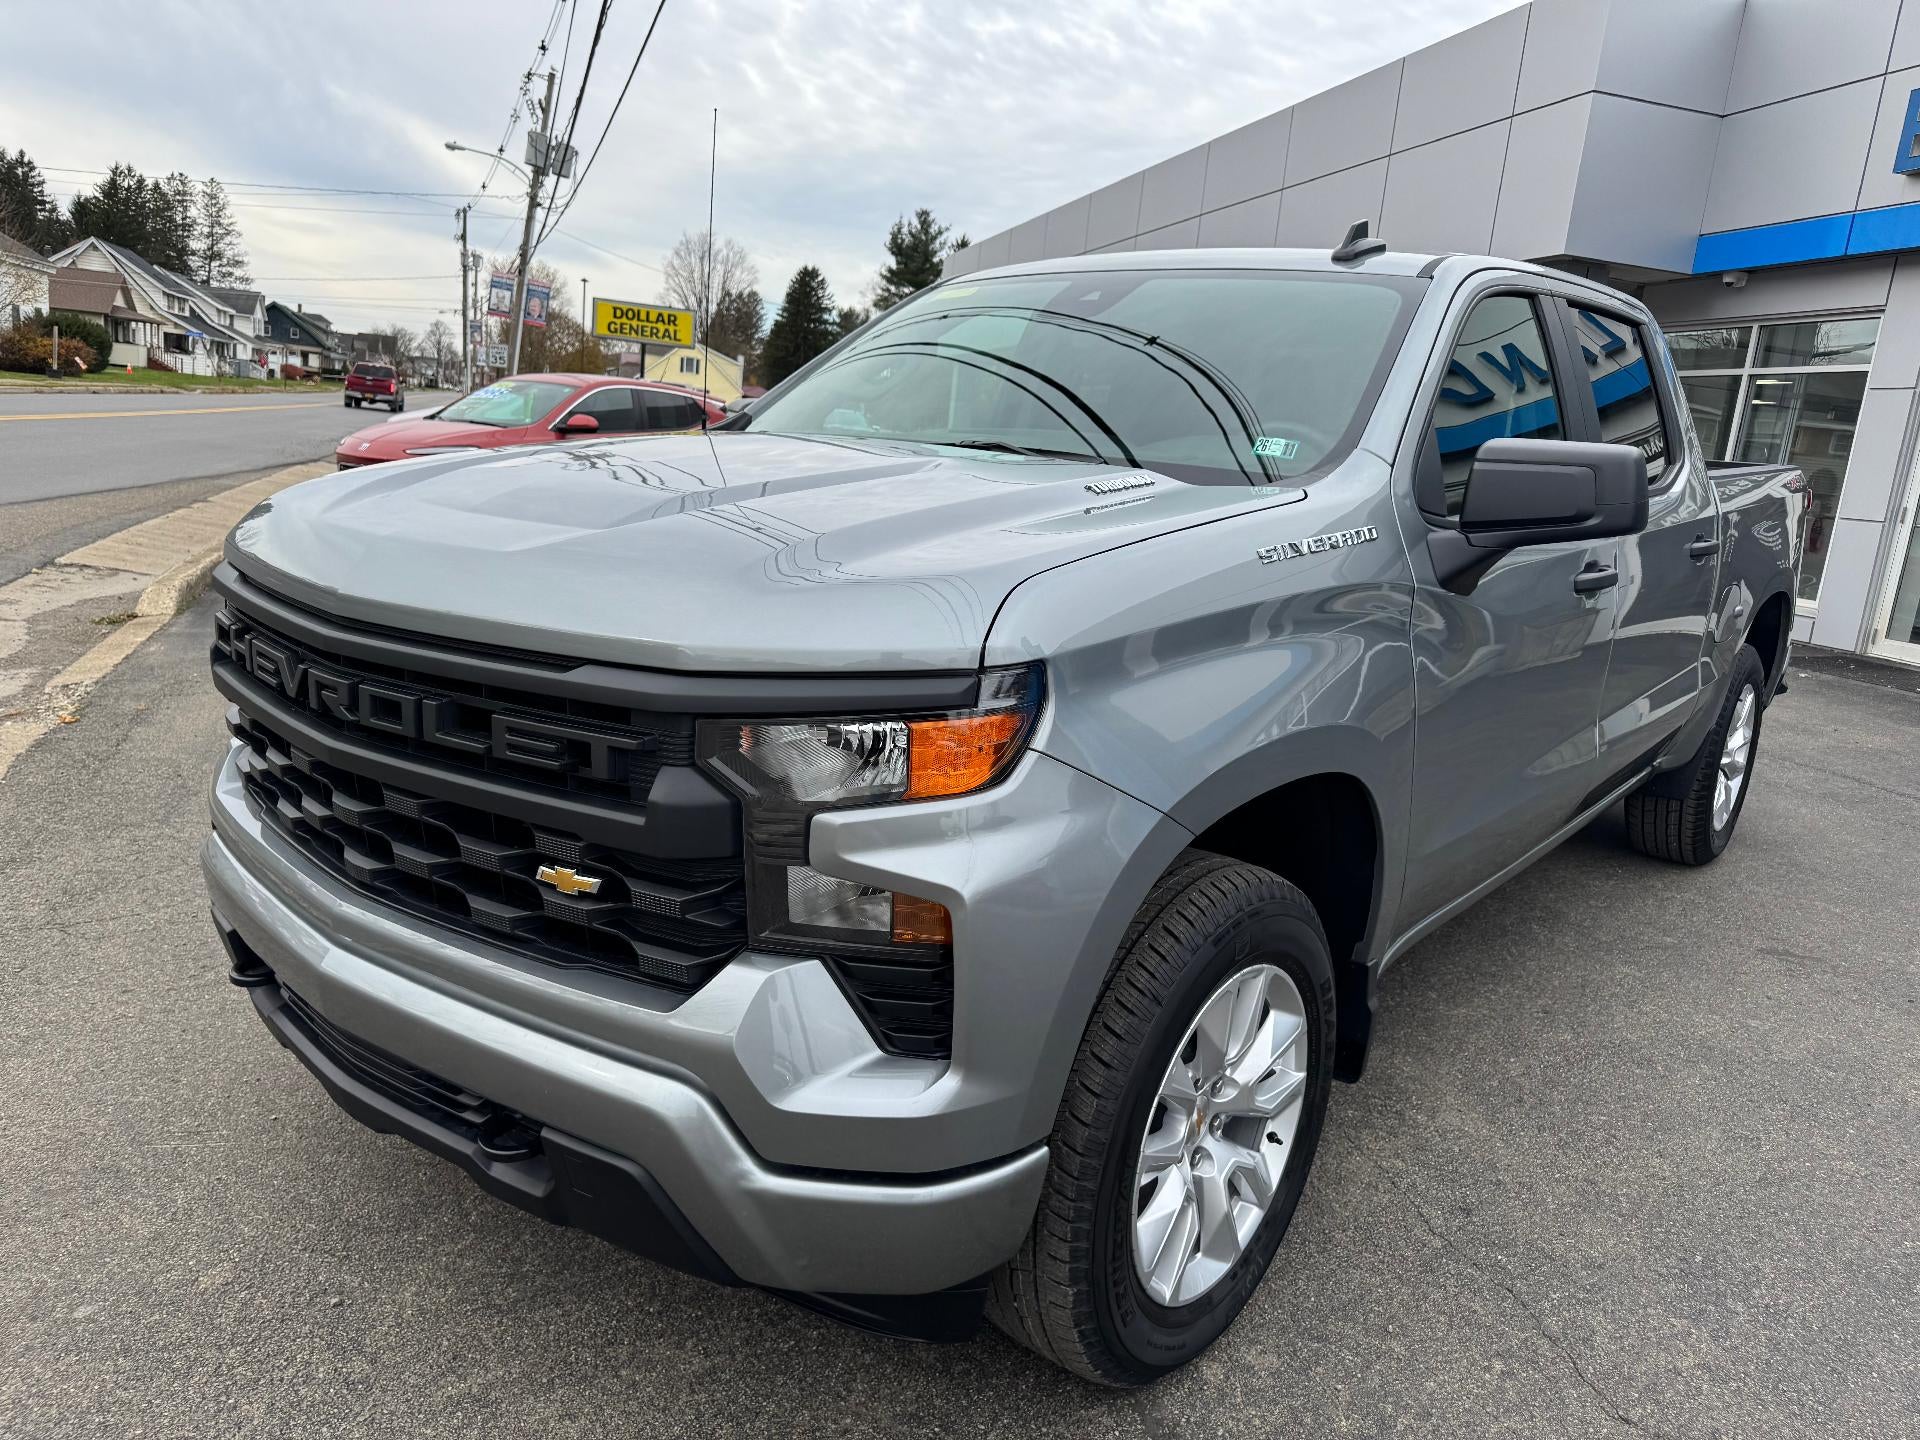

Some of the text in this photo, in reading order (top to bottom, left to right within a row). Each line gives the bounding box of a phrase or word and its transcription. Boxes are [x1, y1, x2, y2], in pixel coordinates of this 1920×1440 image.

[612, 306, 678, 327] DOLLAR
[607, 321, 683, 342] GENERAL
[491, 356, 506, 365] 35
[1255, 438, 1270, 452] 26
[1084, 474, 1155, 495] TURBOMAX
[1256, 525, 1379, 565] SILVERADO
[214, 609, 660, 782] CHEVROLET
